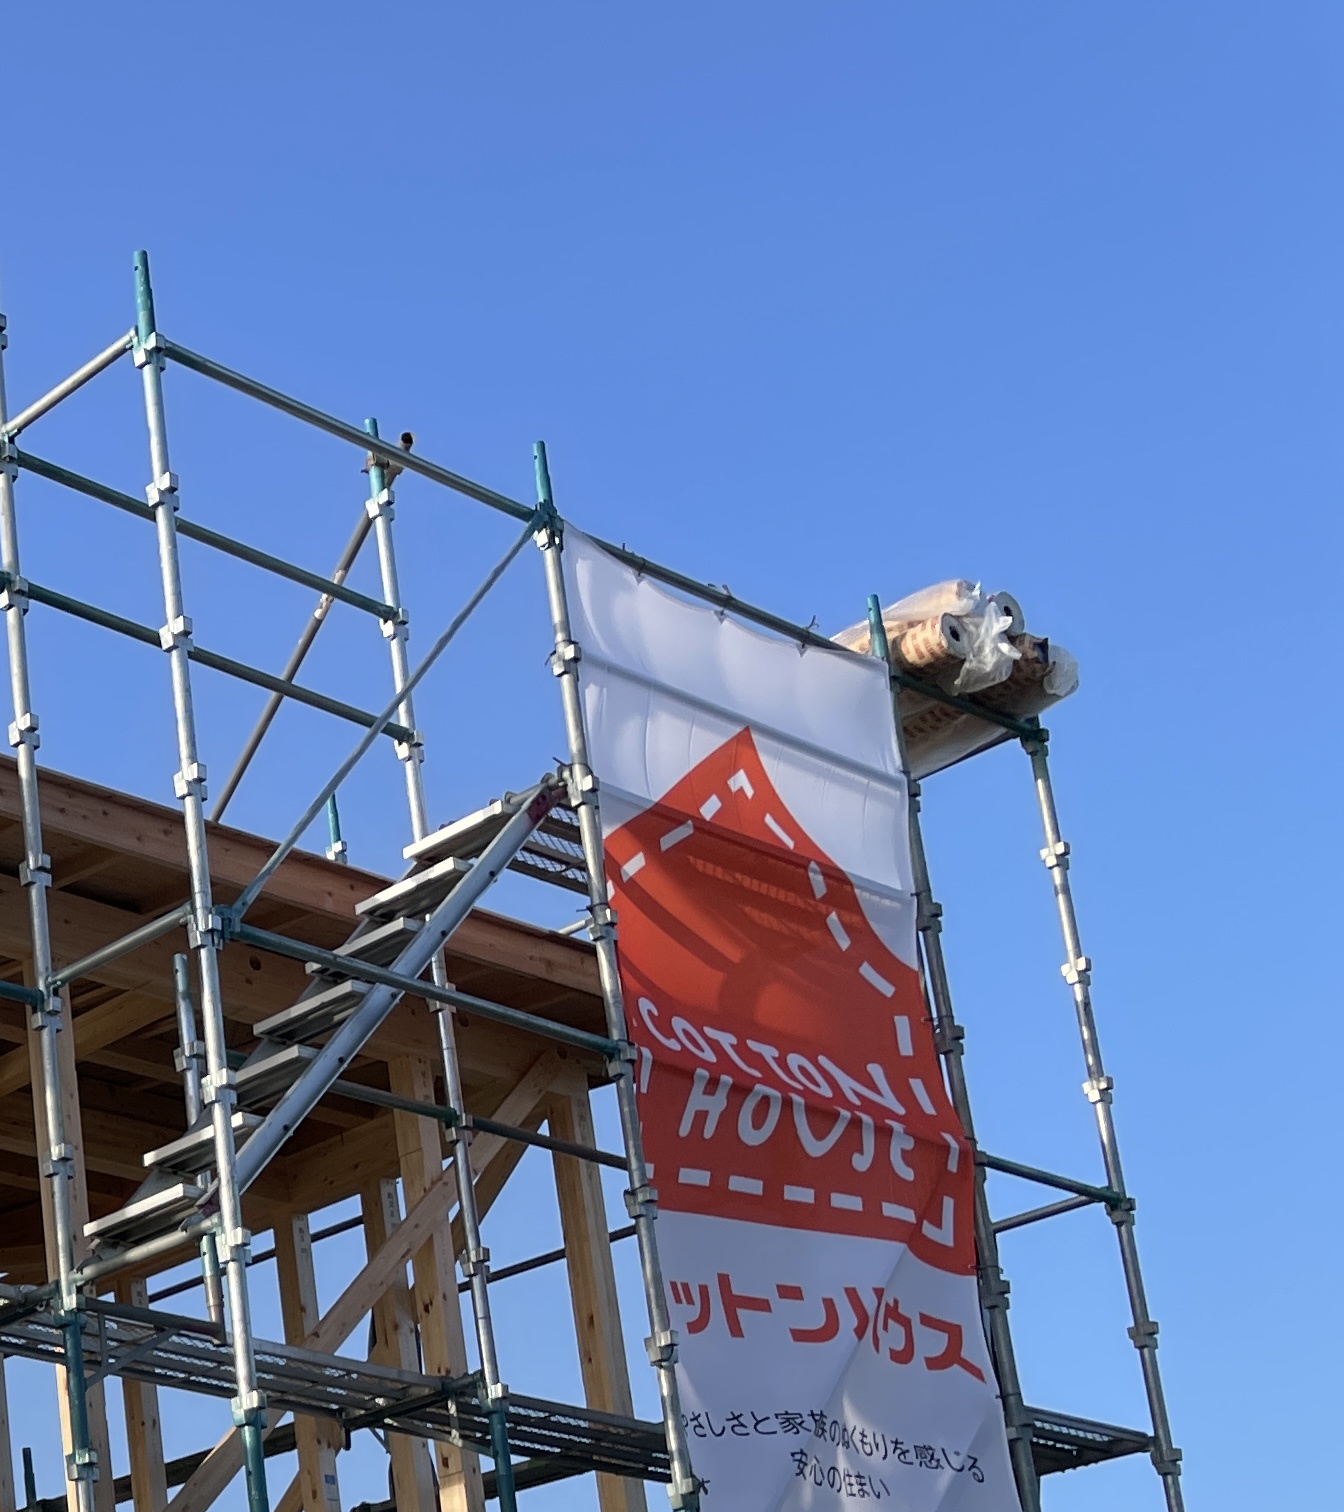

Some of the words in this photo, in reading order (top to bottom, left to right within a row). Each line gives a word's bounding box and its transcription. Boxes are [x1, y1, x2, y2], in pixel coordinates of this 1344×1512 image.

[638, 997, 906, 1116] COTTON
[678, 1068, 915, 1182] HOUSE
[791, 1448, 891, 1500] 安心の住まい
